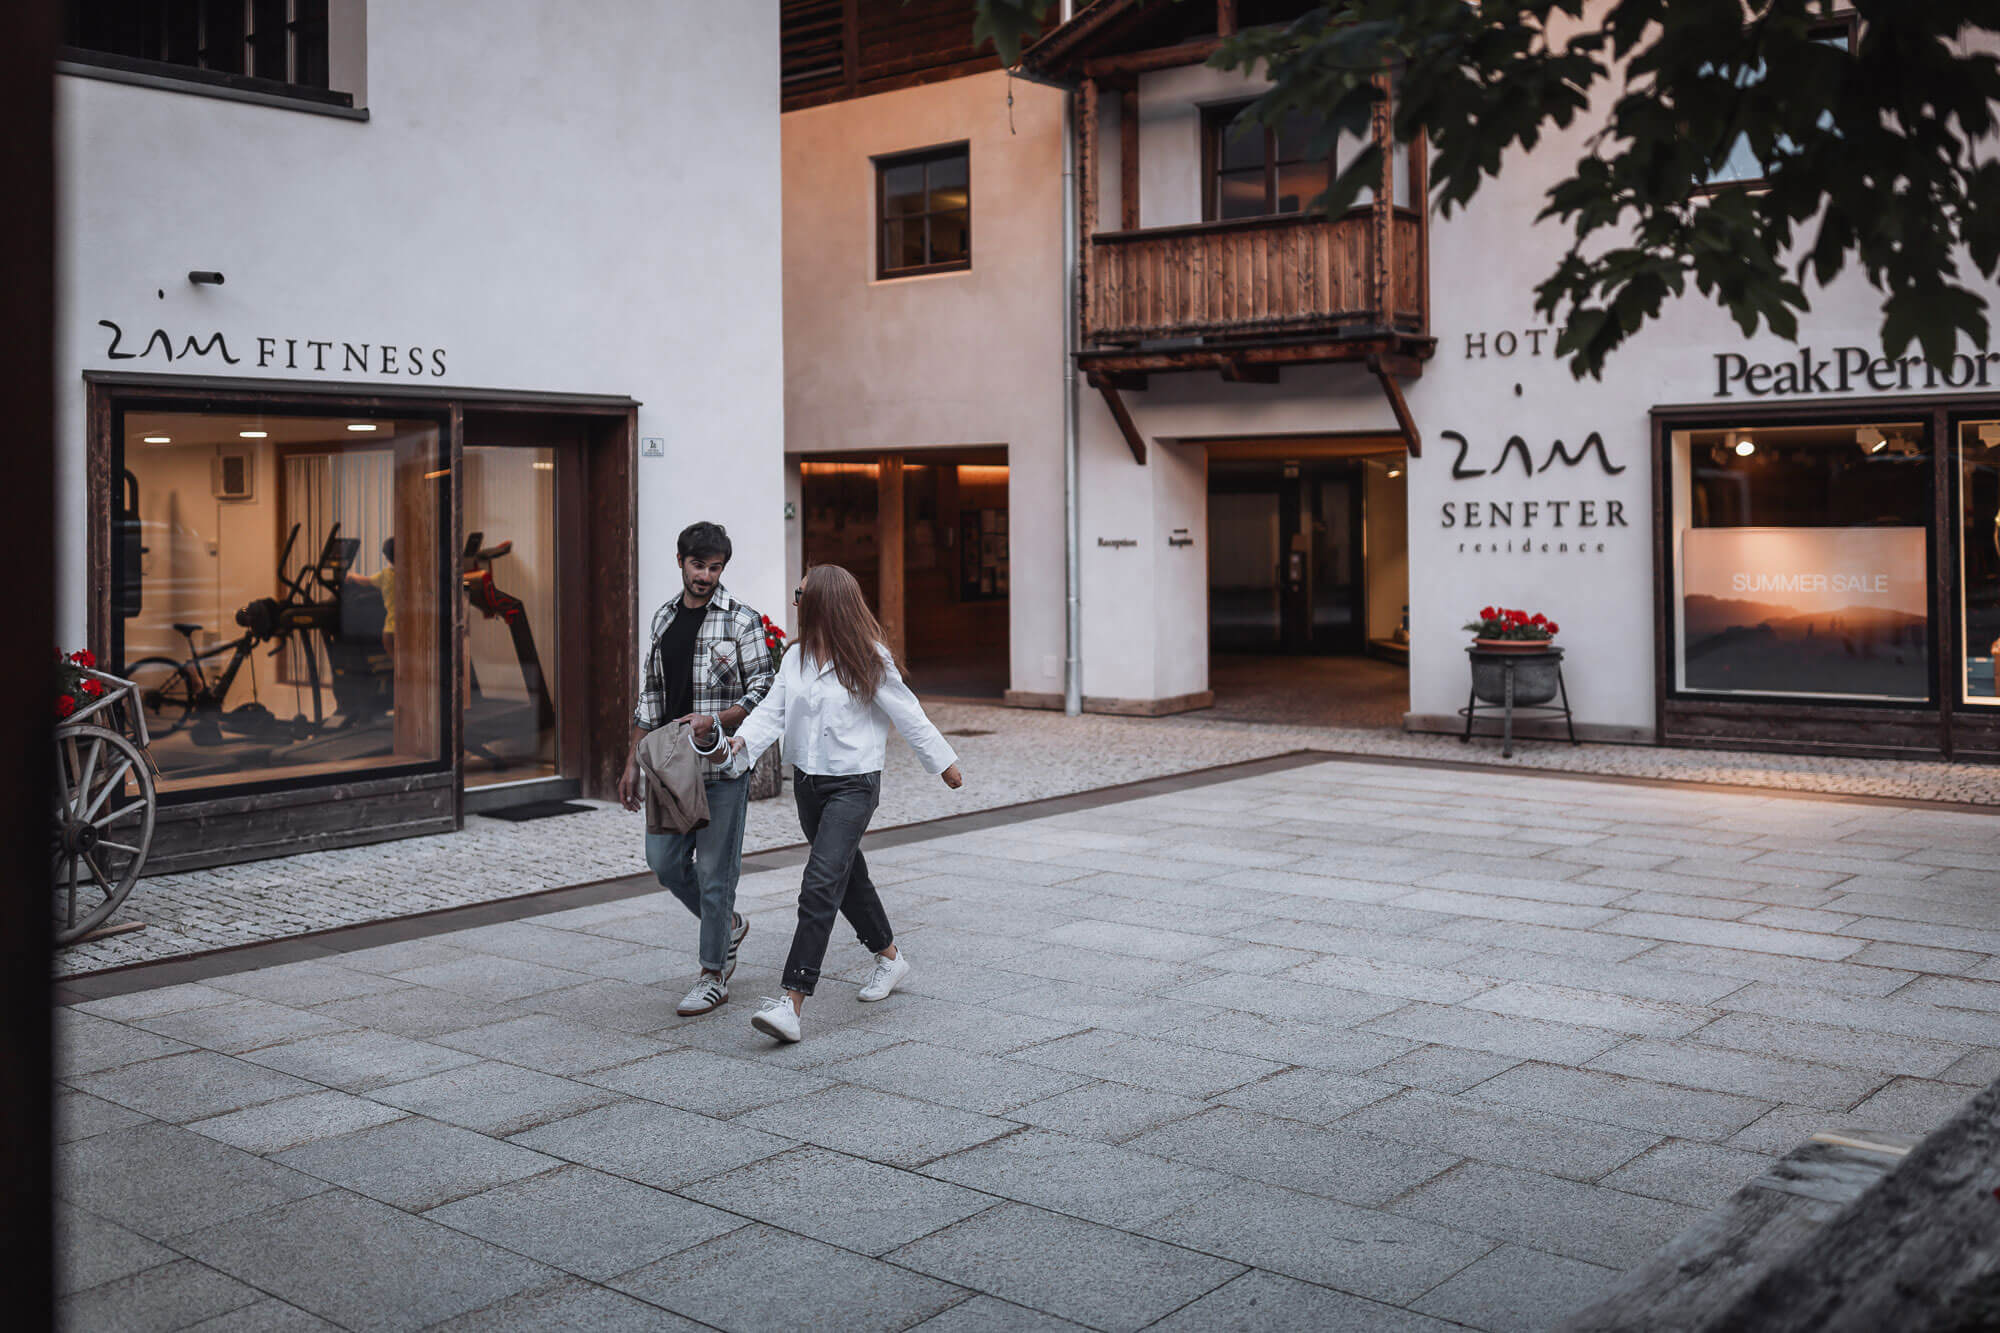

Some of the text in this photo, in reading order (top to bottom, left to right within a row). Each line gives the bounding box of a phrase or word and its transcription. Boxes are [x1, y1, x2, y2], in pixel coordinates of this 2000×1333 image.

[256, 337, 446, 377] FITNESS
[1465, 327, 1568, 359] HOT
[1441, 500, 1629, 528] SENFTER
[1458, 537, 1606, 552] residence
[1732, 574, 1888, 593] SUMMER SALE
